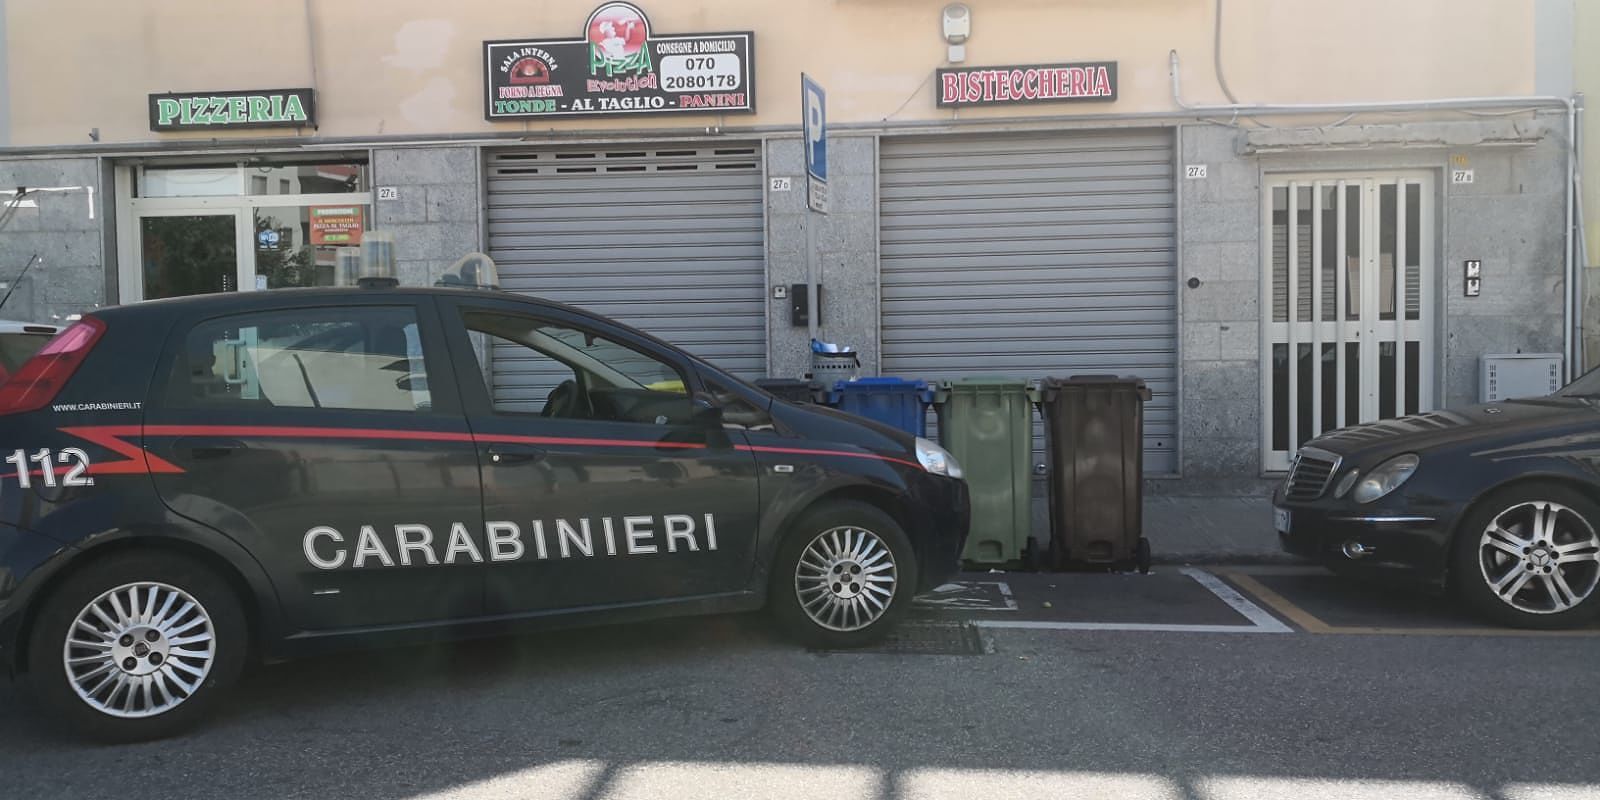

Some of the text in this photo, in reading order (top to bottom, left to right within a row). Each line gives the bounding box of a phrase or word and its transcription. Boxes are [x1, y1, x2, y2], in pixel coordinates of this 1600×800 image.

[656, 40, 736, 54] CONSEGNE A DOMICILIO
[500, 47, 558, 73] SALA INTERNA
[685, 57, 716, 70] 070
[499, 84, 563, 98] FORNO A LEGNA
[665, 74, 736, 89] 2080178
[942, 66, 1112, 102] BISTECCHERIA
[157, 94, 308, 125] PIZZERIA
[494, 99, 557, 113] TONDE
[571, 98, 594, 111] AL
[598, 95, 665, 110] TAGLIO
[680, 93, 745, 108] PANINI
[808, 87, 823, 165] P
[52, 402, 142, 412] WWW.CARABINIERI.IT
[5, 447, 94, 489] 112
[302, 513, 718, 570] CARABINIERI
